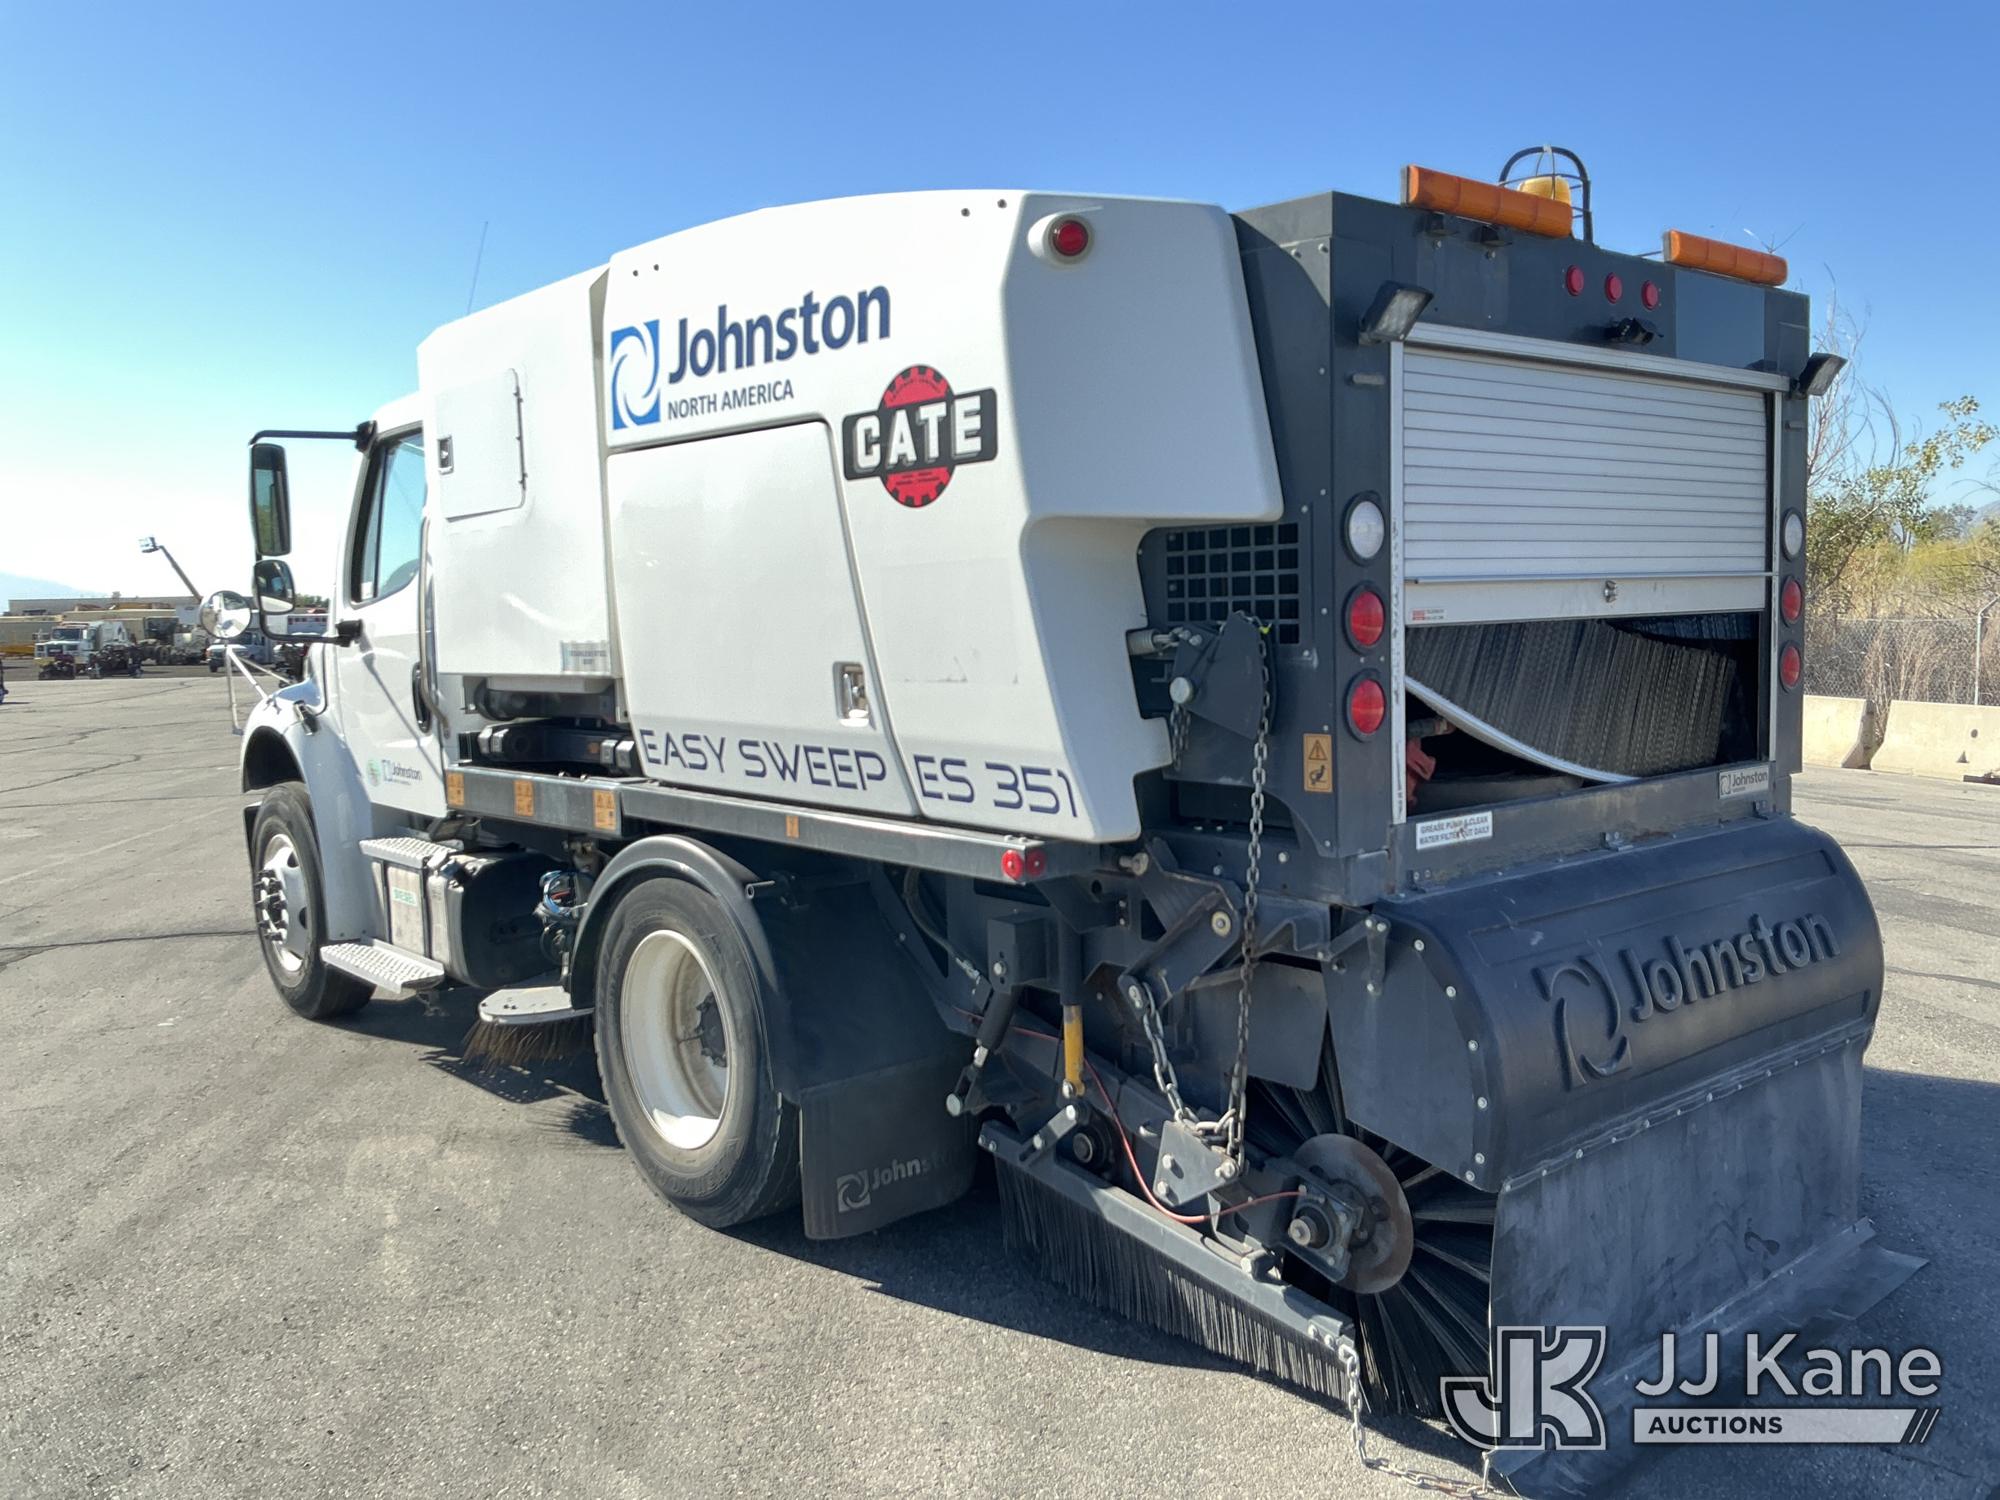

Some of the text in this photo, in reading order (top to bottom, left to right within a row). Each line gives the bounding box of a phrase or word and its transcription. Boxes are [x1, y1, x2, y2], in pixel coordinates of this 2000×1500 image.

[668, 285, 891, 385] Johnston
[667, 379, 794, 421] NORTH AMERICA
[853, 394, 982, 474] CATE
[639, 728, 1078, 818] EASY SWEEP ES 351
[1732, 771, 1768, 786] Johnston
[1618, 911, 1841, 1023] Johnston
